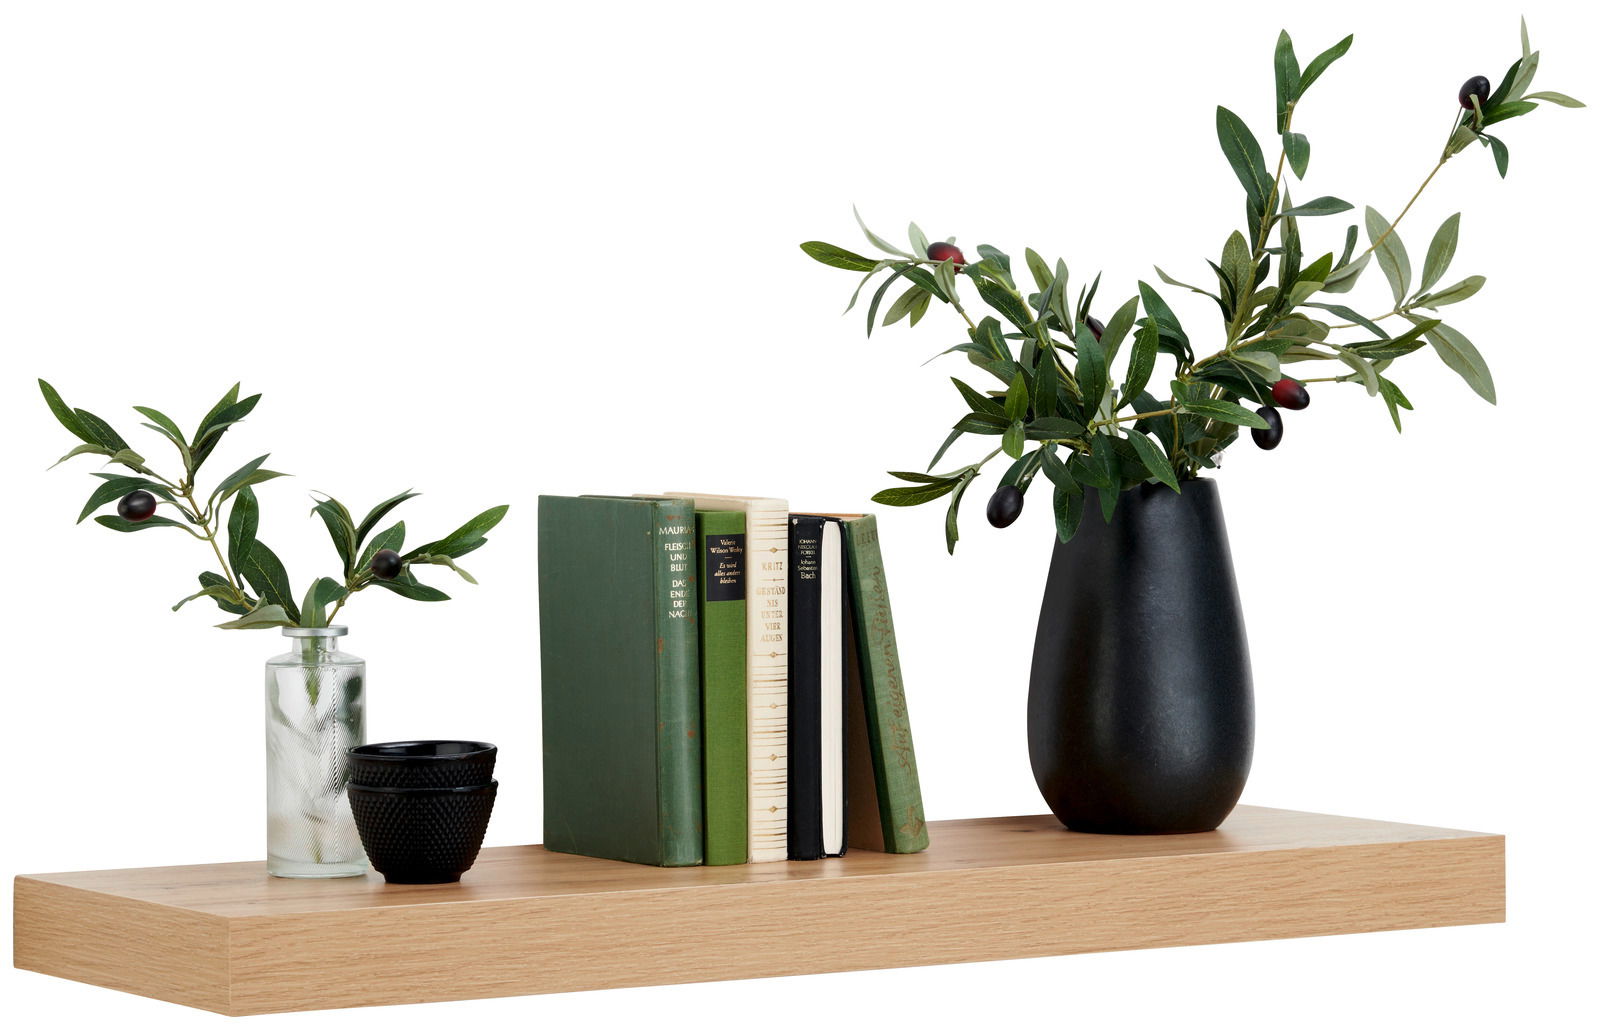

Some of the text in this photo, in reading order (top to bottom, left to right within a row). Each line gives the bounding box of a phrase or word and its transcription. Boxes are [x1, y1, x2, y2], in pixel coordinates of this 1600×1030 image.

[670, 553, 688, 561] UND
[670, 563, 688, 572] BLUT
[800, 571, 817, 579] Bach
[765, 622, 781, 631] VIER
